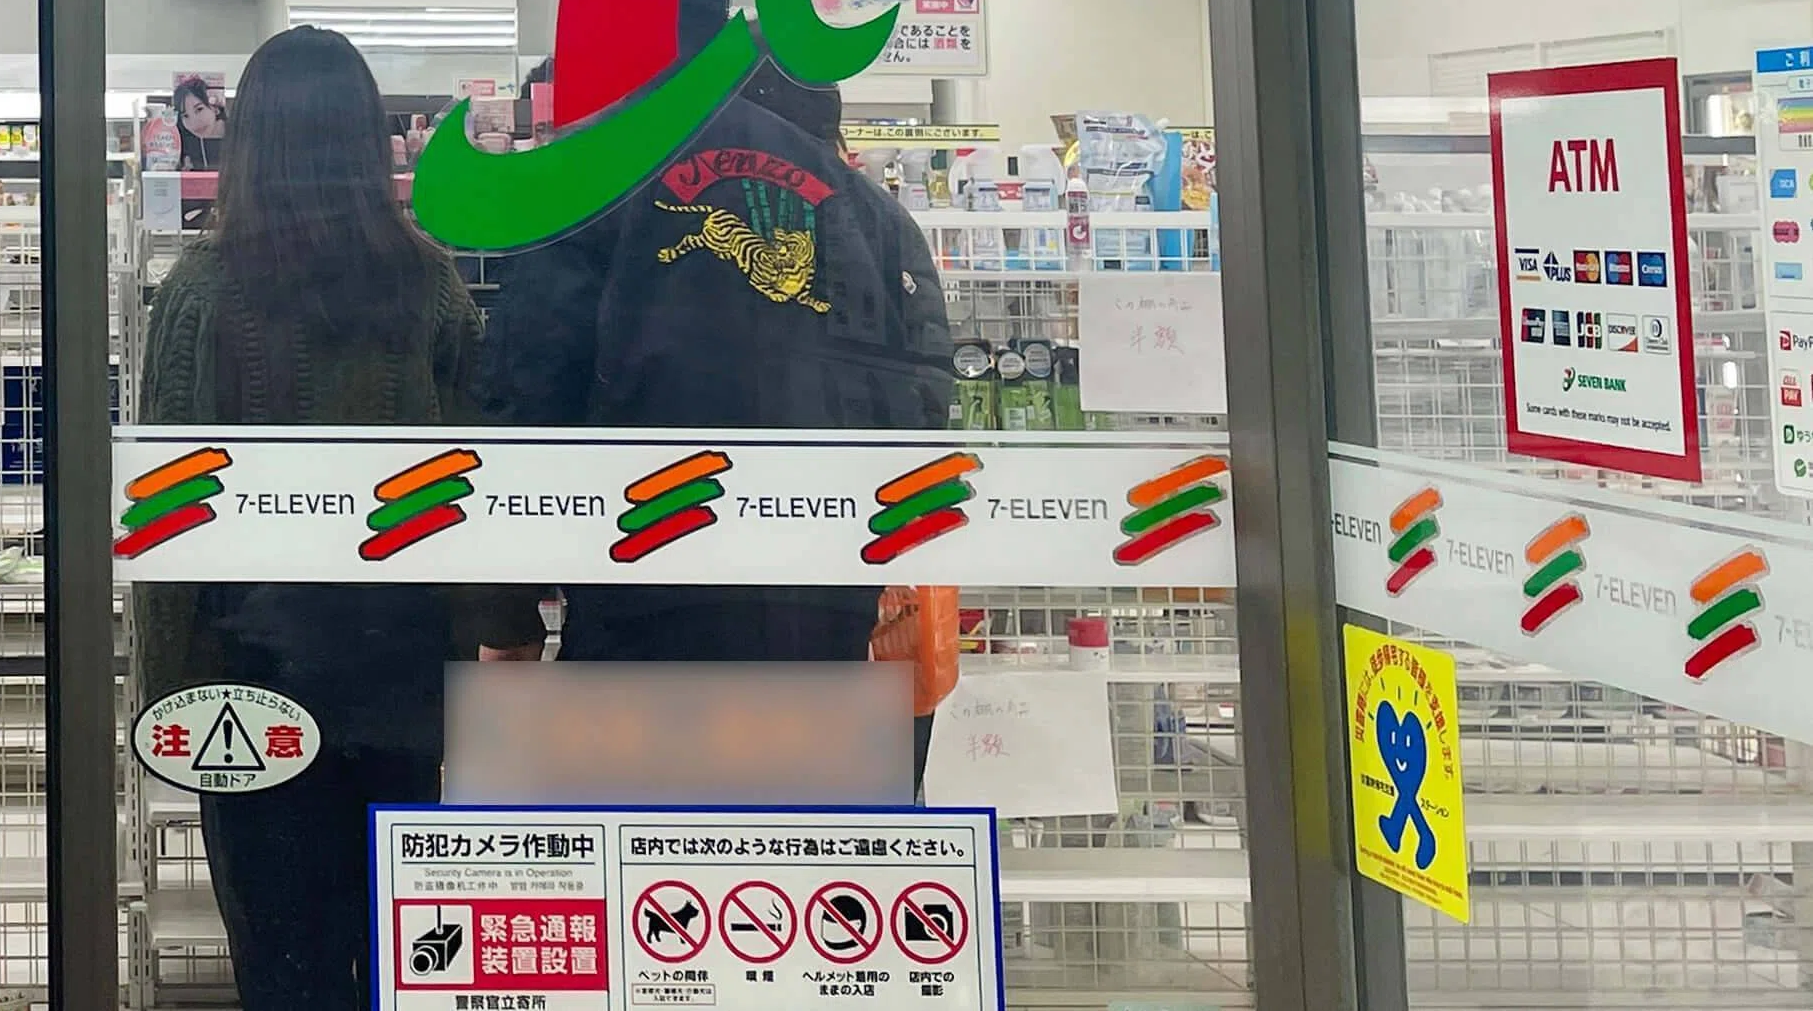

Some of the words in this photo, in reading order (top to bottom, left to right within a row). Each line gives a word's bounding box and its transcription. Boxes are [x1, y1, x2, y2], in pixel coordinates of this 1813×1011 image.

[1548, 138, 1620, 194] ATM
[1519, 257, 1539, 272] VISA
[1549, 267, 1572, 283] PLUS
[1577, 323, 1603, 338] JCB
[1578, 373, 1602, 390] SEVEN
[1603, 376, 1627, 392] BANK
[1526, 402, 1541, 414] Some
[1632, 416, 1640, 427] be
[199, 773, 257, 788] 自動ドア
[401, 833, 596, 859] 防犯カメラ作動中
[630, 837, 965, 858] 店内では次のような行為はご遠慮ください。
[424, 868, 462, 879] Security
[464, 868, 502, 878] Camera
[504, 868, 513, 878] is
[515, 868, 524, 878] in
[526, 868, 574, 879] Operation
[480, 914, 597, 944] 緊急通報
[481, 946, 598, 975] 装置設置
[638, 970, 709, 982] ペットの同伴
[802, 971, 890, 983] ヘルメット着用の
[909, 971, 955, 983] 店内での
[818, 984, 875, 997] ままの入店
[921, 984, 944, 997] 撮影
[455, 995, 547, 1011] 警察官立寄所
